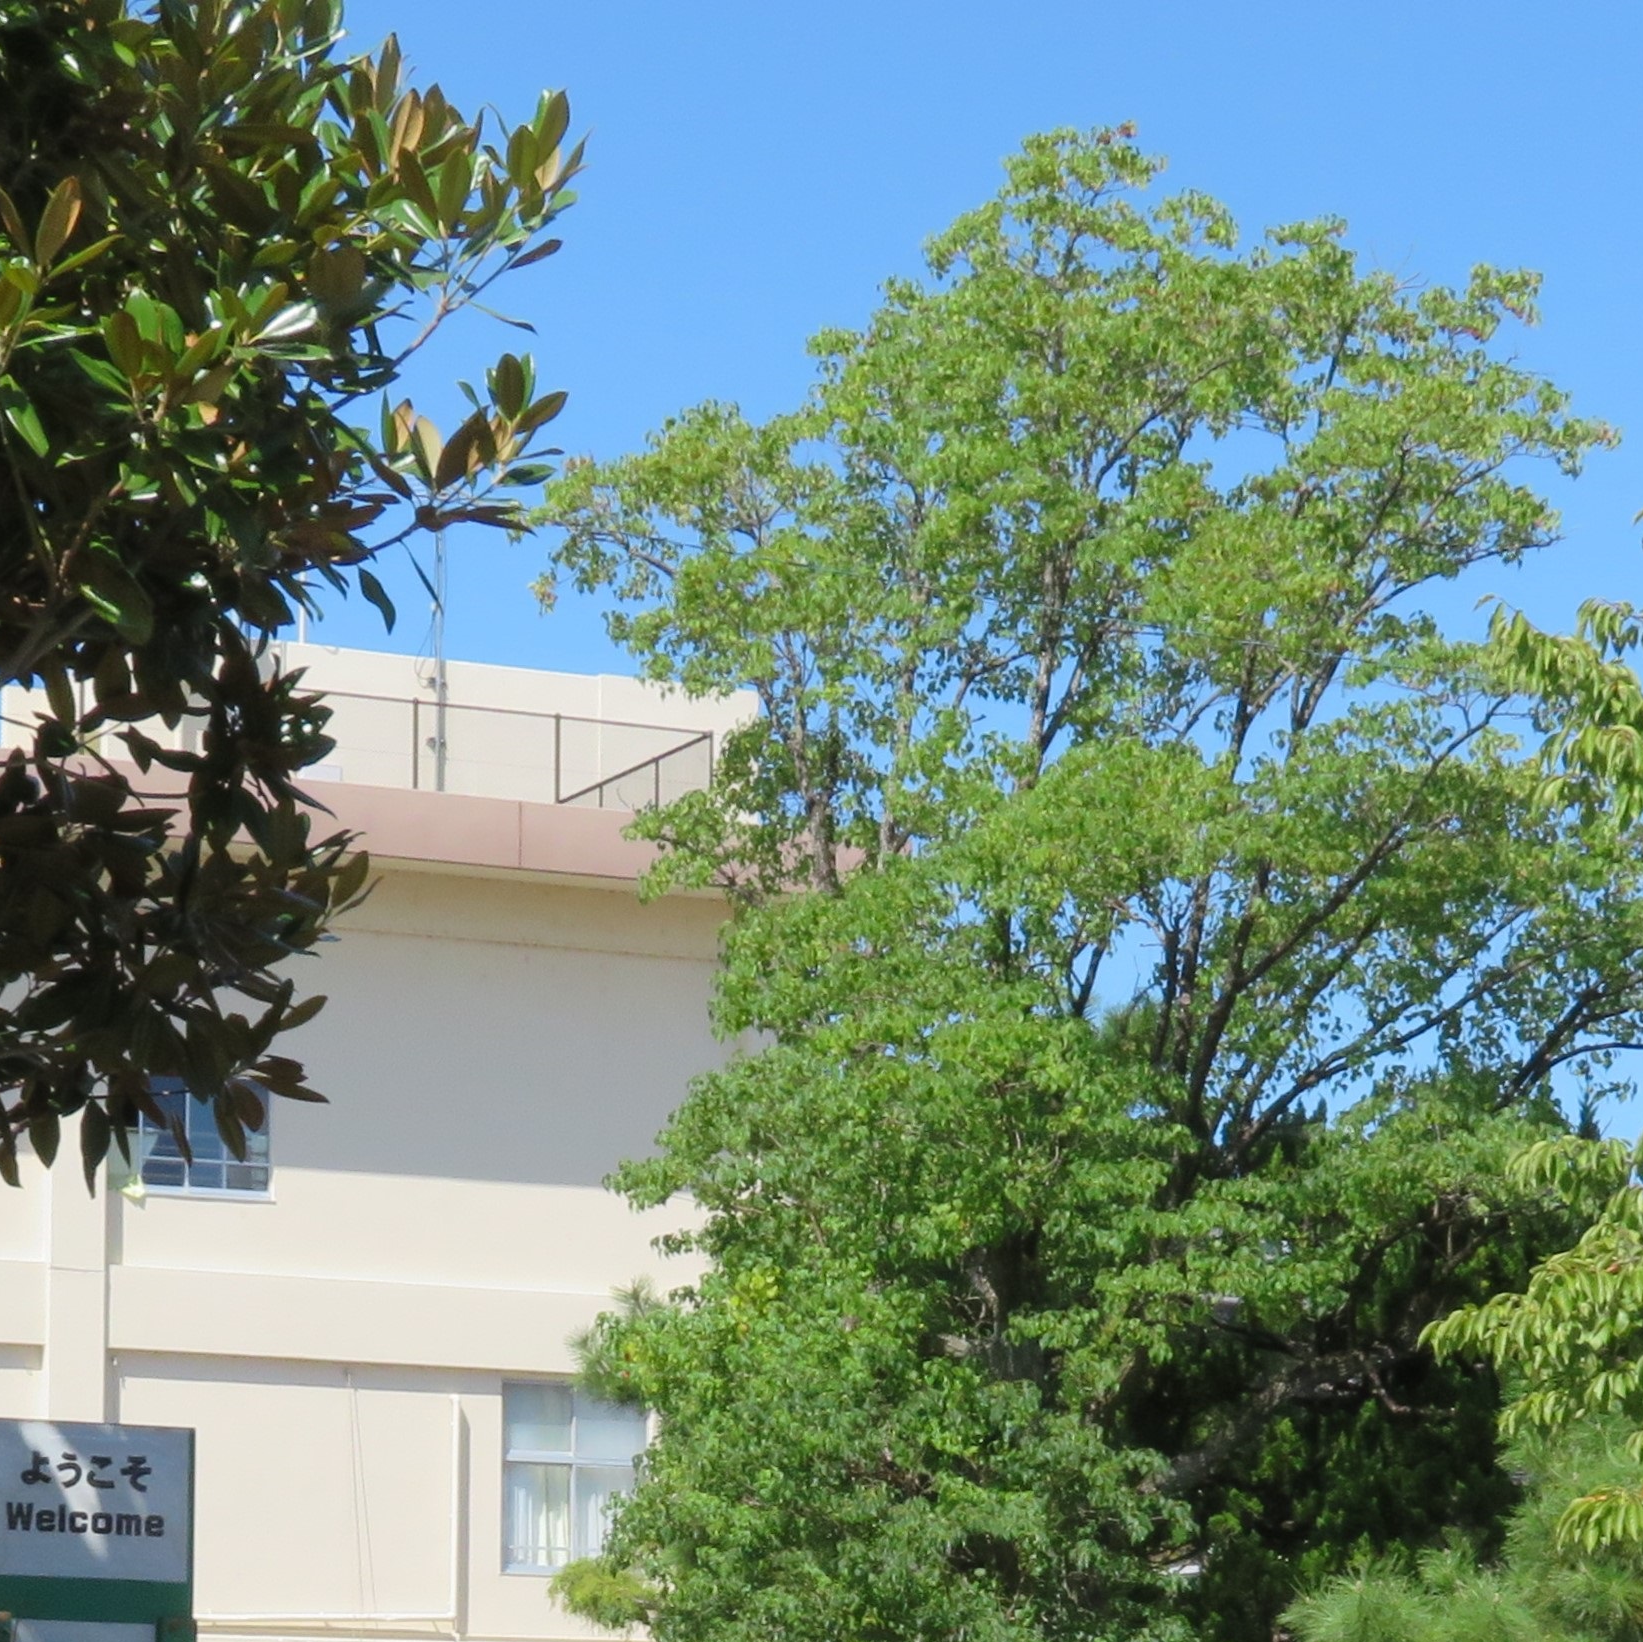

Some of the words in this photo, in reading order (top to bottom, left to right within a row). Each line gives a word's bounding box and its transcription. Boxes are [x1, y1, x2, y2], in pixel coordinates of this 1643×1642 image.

[20, 1450, 152, 1493] ようこそ
[6, 1502, 165, 1537] Welcome
